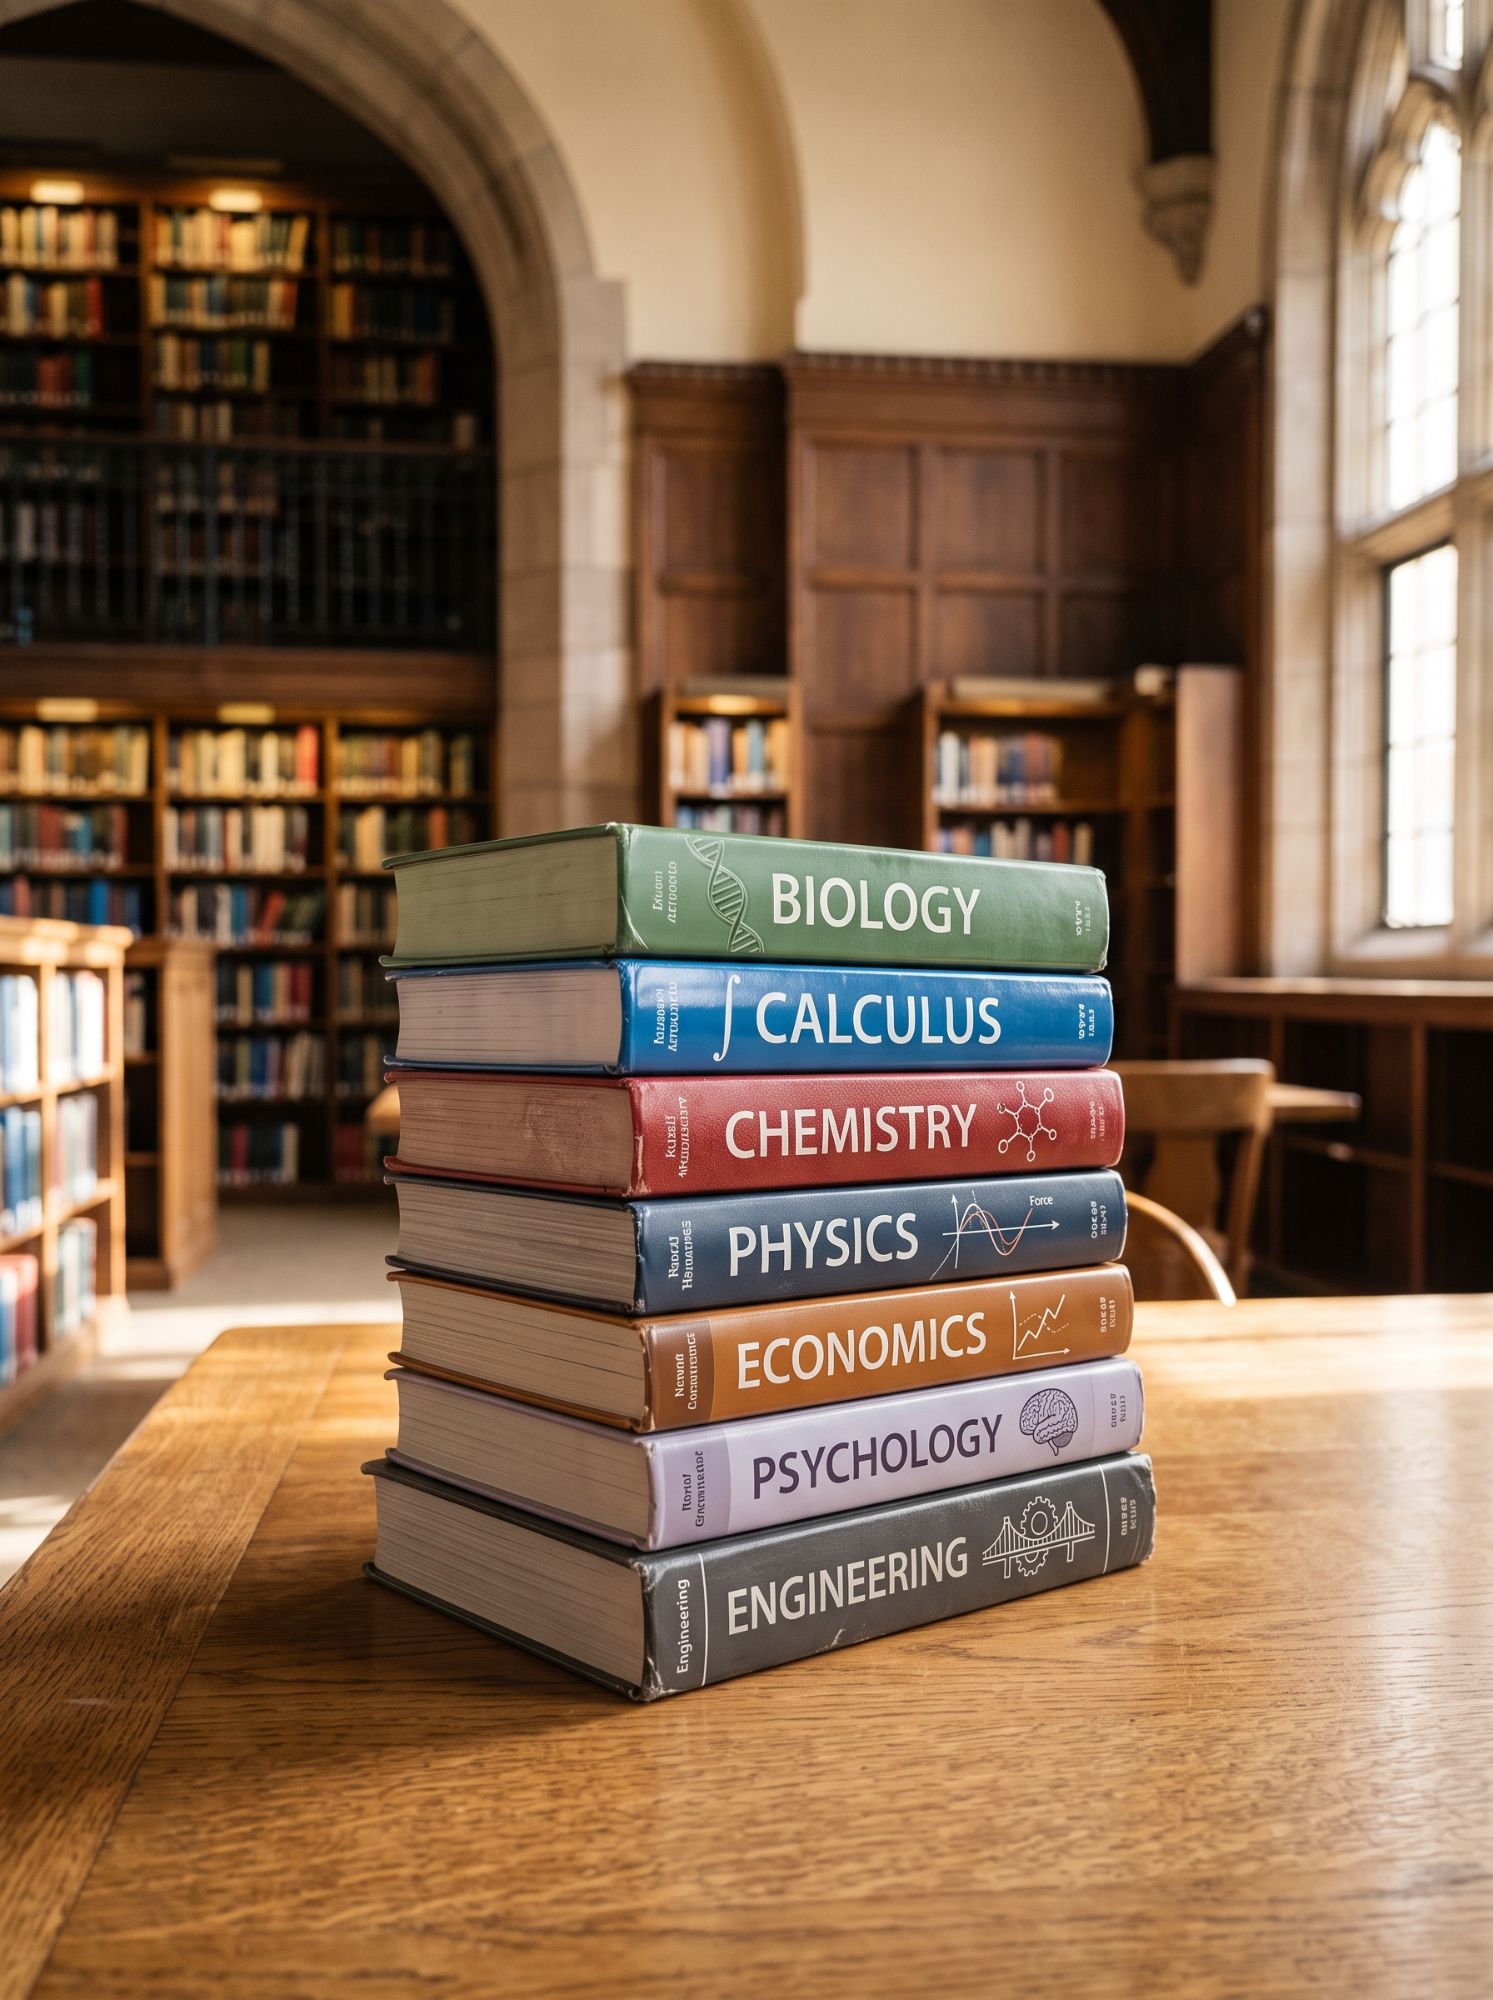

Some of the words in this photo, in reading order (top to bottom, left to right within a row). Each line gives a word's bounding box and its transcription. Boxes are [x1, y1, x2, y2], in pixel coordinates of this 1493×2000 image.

[771, 873, 980, 935] BIOLOGY
[756, 991, 1001, 1045] CALCULUS
[725, 1103, 977, 1159] CHEMISTRY
[1029, 1195, 1054, 1206] Force
[728, 1213, 919, 1277] PHYSICS
[737, 1312, 987, 1390] ECONOMICS
[753, 1414, 1003, 1499] PSYCHOLOGY
[727, 1537, 969, 1635] ENGINEERING
[676, 1578, 693, 1674] Engineering
